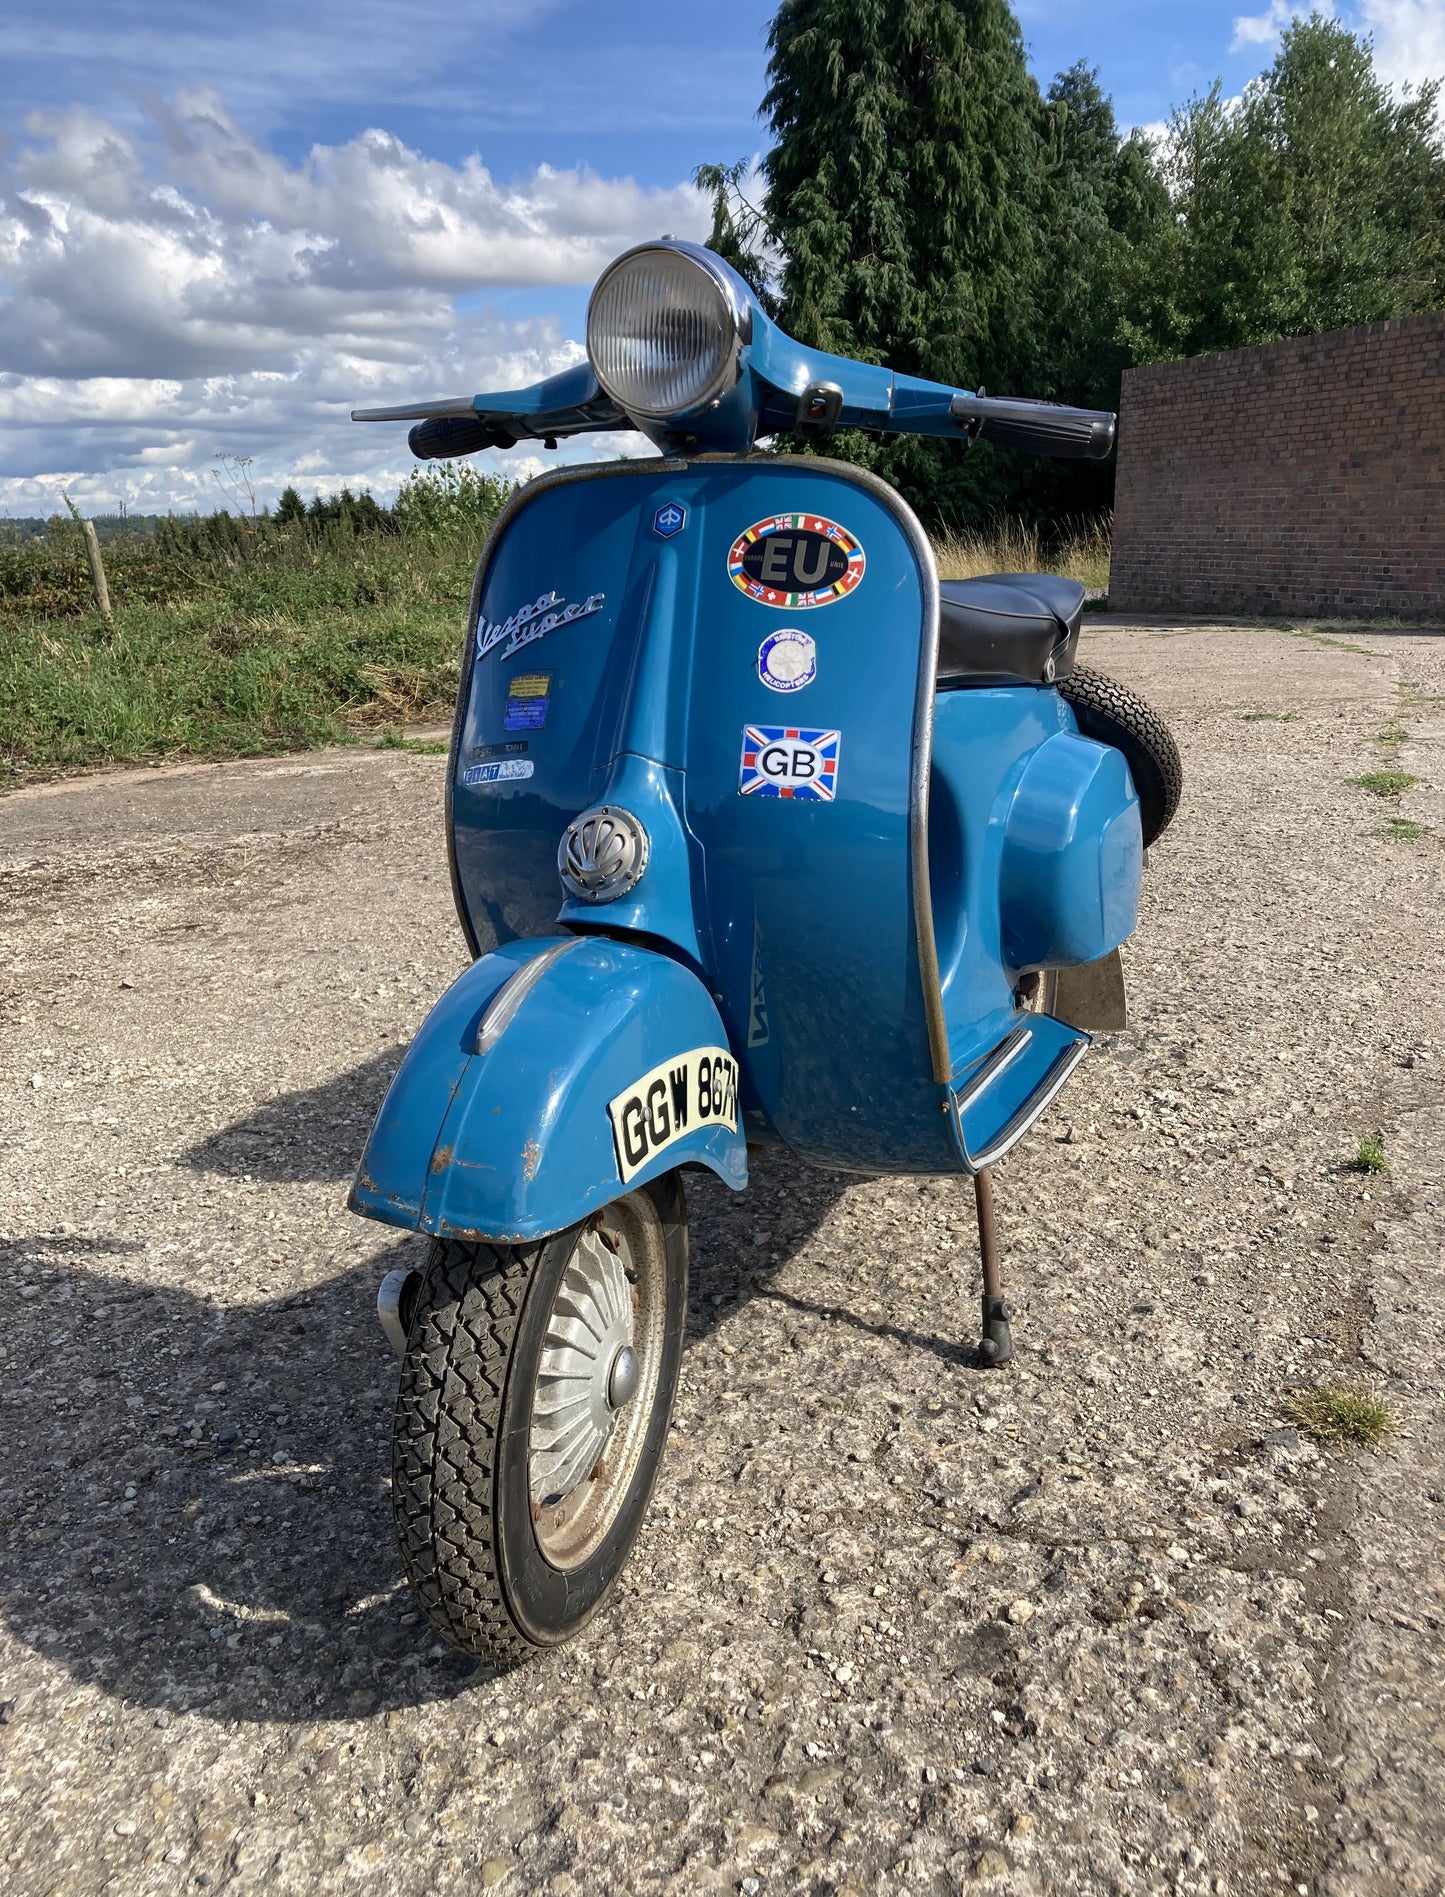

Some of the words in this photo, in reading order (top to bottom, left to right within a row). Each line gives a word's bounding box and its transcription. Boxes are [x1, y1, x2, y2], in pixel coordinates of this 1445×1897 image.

[760, 538, 831, 584] EU
[476, 591, 565, 660] Vespa
[763, 671, 809, 689] HELICOPTERS
[465, 765, 499, 783] FIAT
[762, 748, 815, 777] GB
[622, 1063, 688, 1167] GGW
